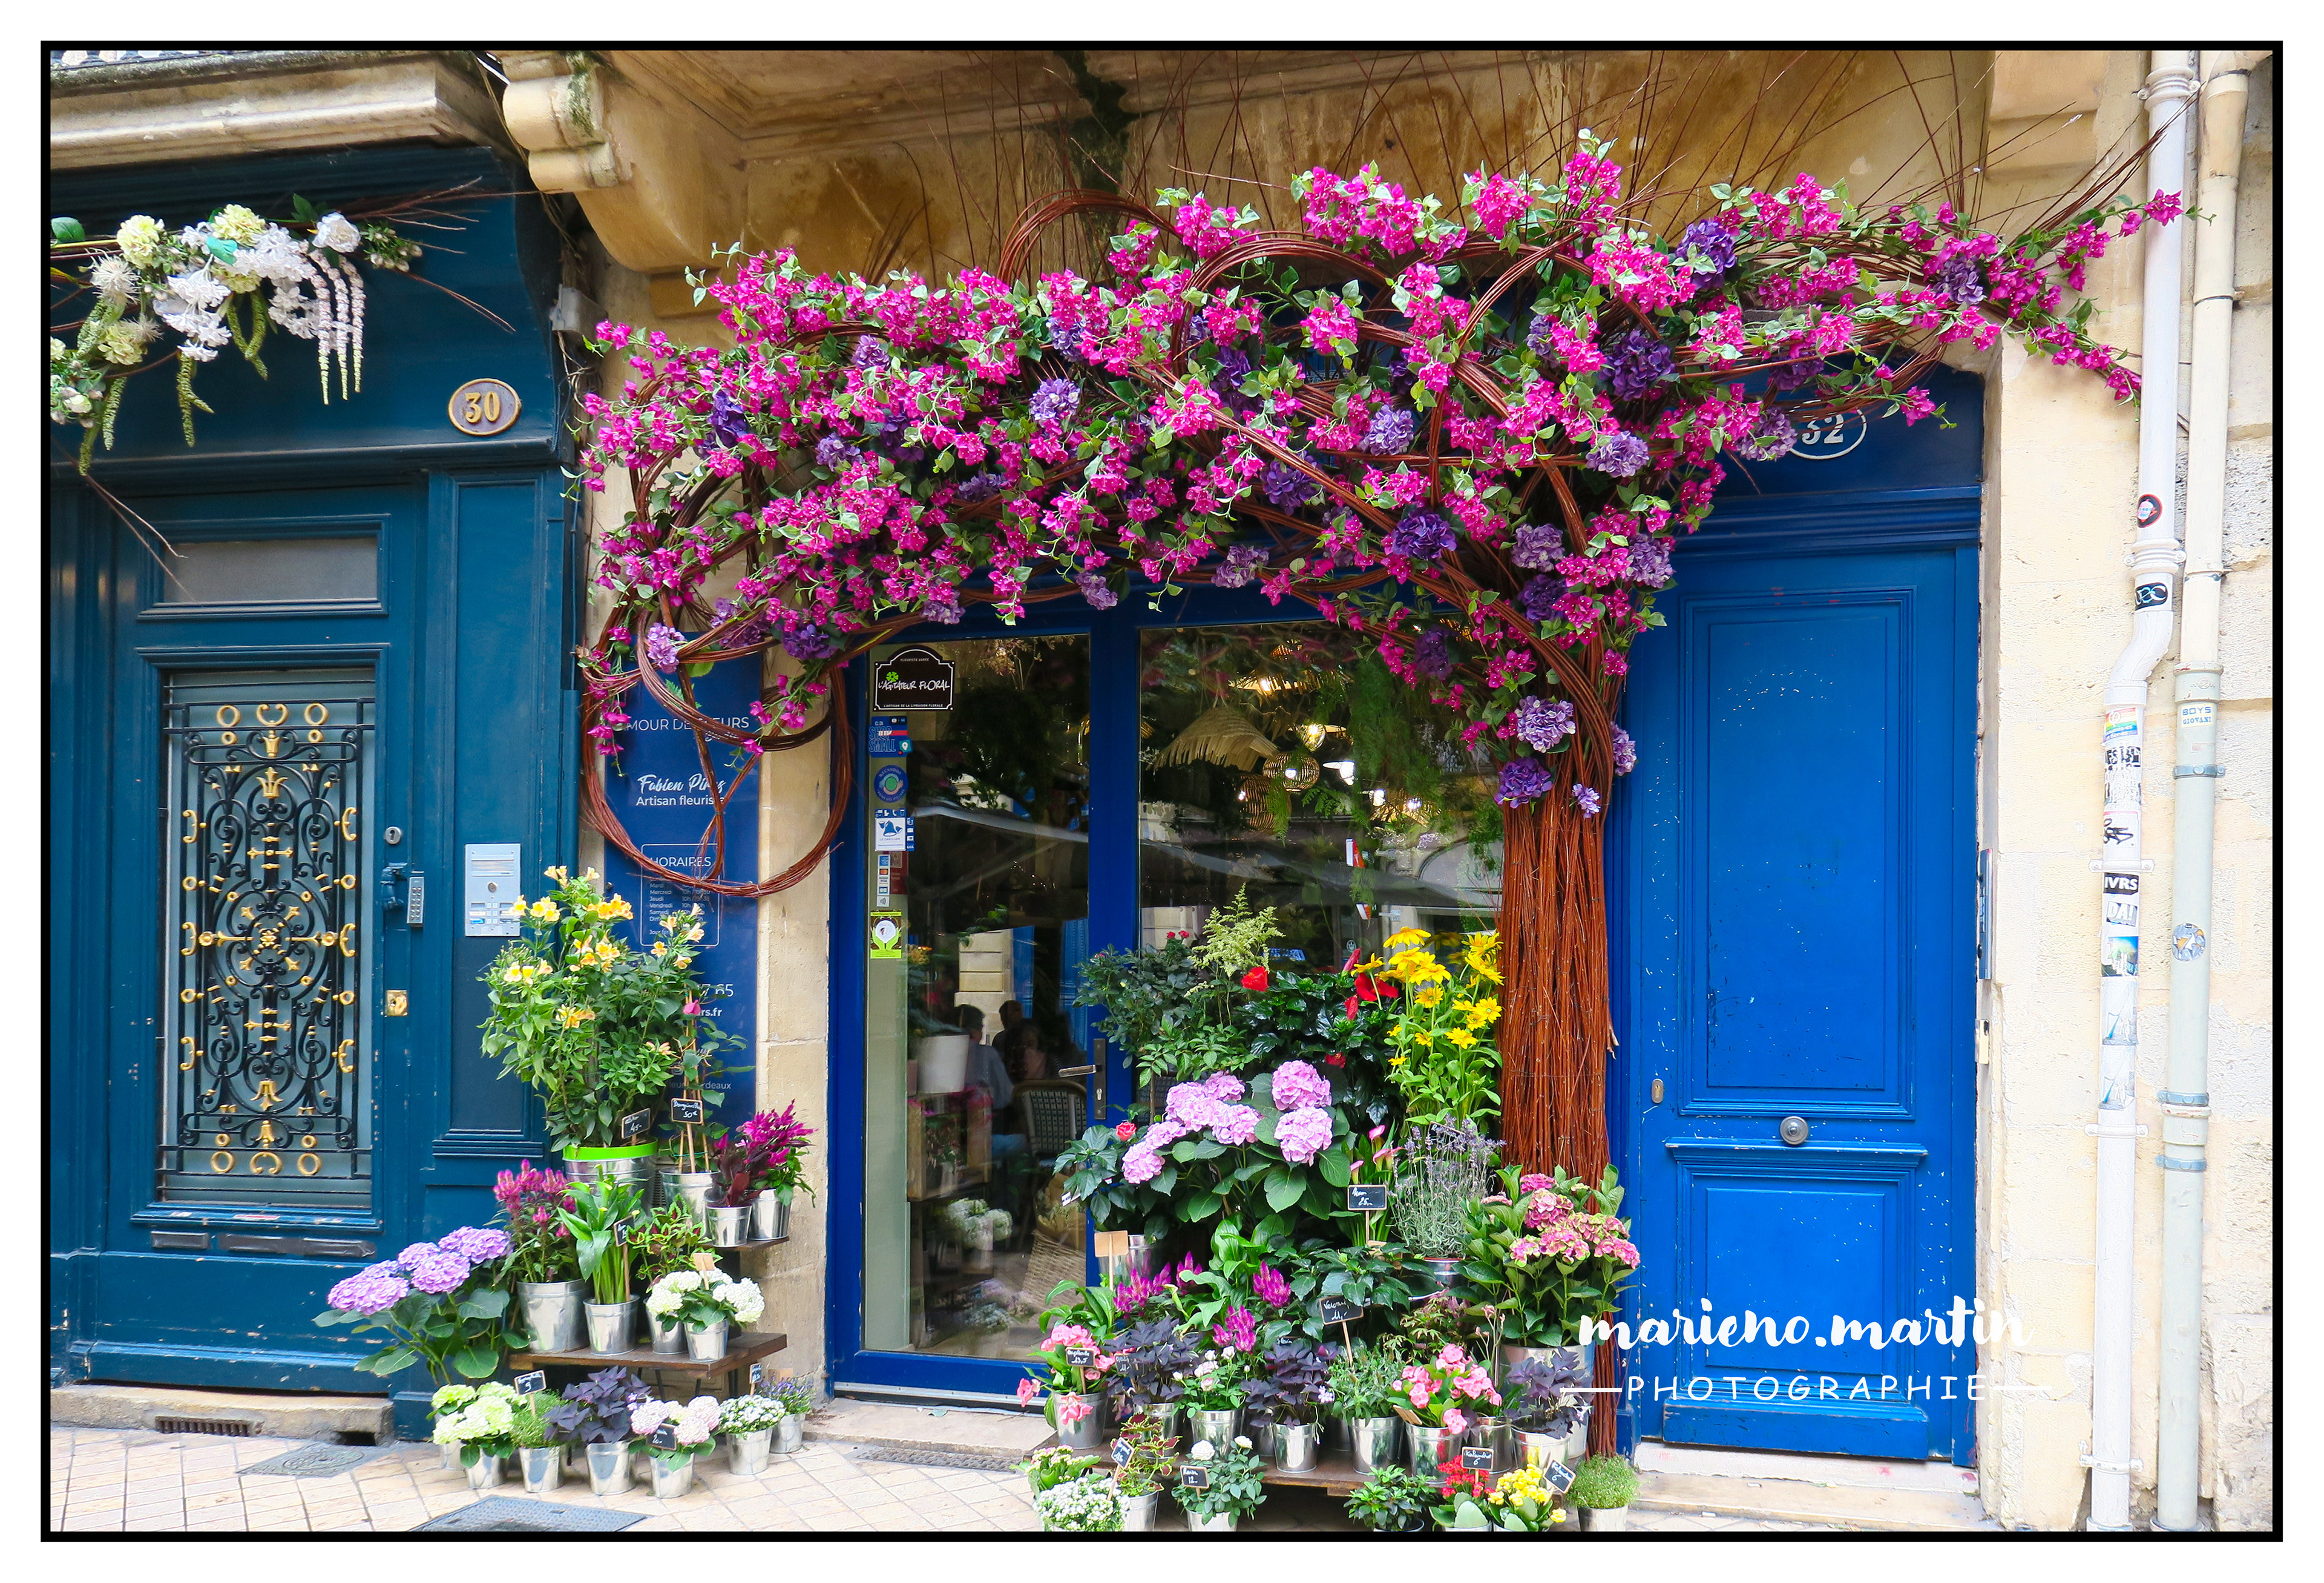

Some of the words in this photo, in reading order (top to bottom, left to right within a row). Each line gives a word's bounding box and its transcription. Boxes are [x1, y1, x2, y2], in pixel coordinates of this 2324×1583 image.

[465, 391, 501, 423] 30
[1802, 413, 1843, 445] 32
[878, 680, 917, 690] L'AGITATEUR
[919, 679, 950, 691] FLORAL
[2182, 706, 2211, 716] BOYS
[869, 738, 896, 752] SMALL
[637, 774, 684, 795] Fabien
[636, 796, 677, 806] Artisan
[715, 983, 734, 997] 65
